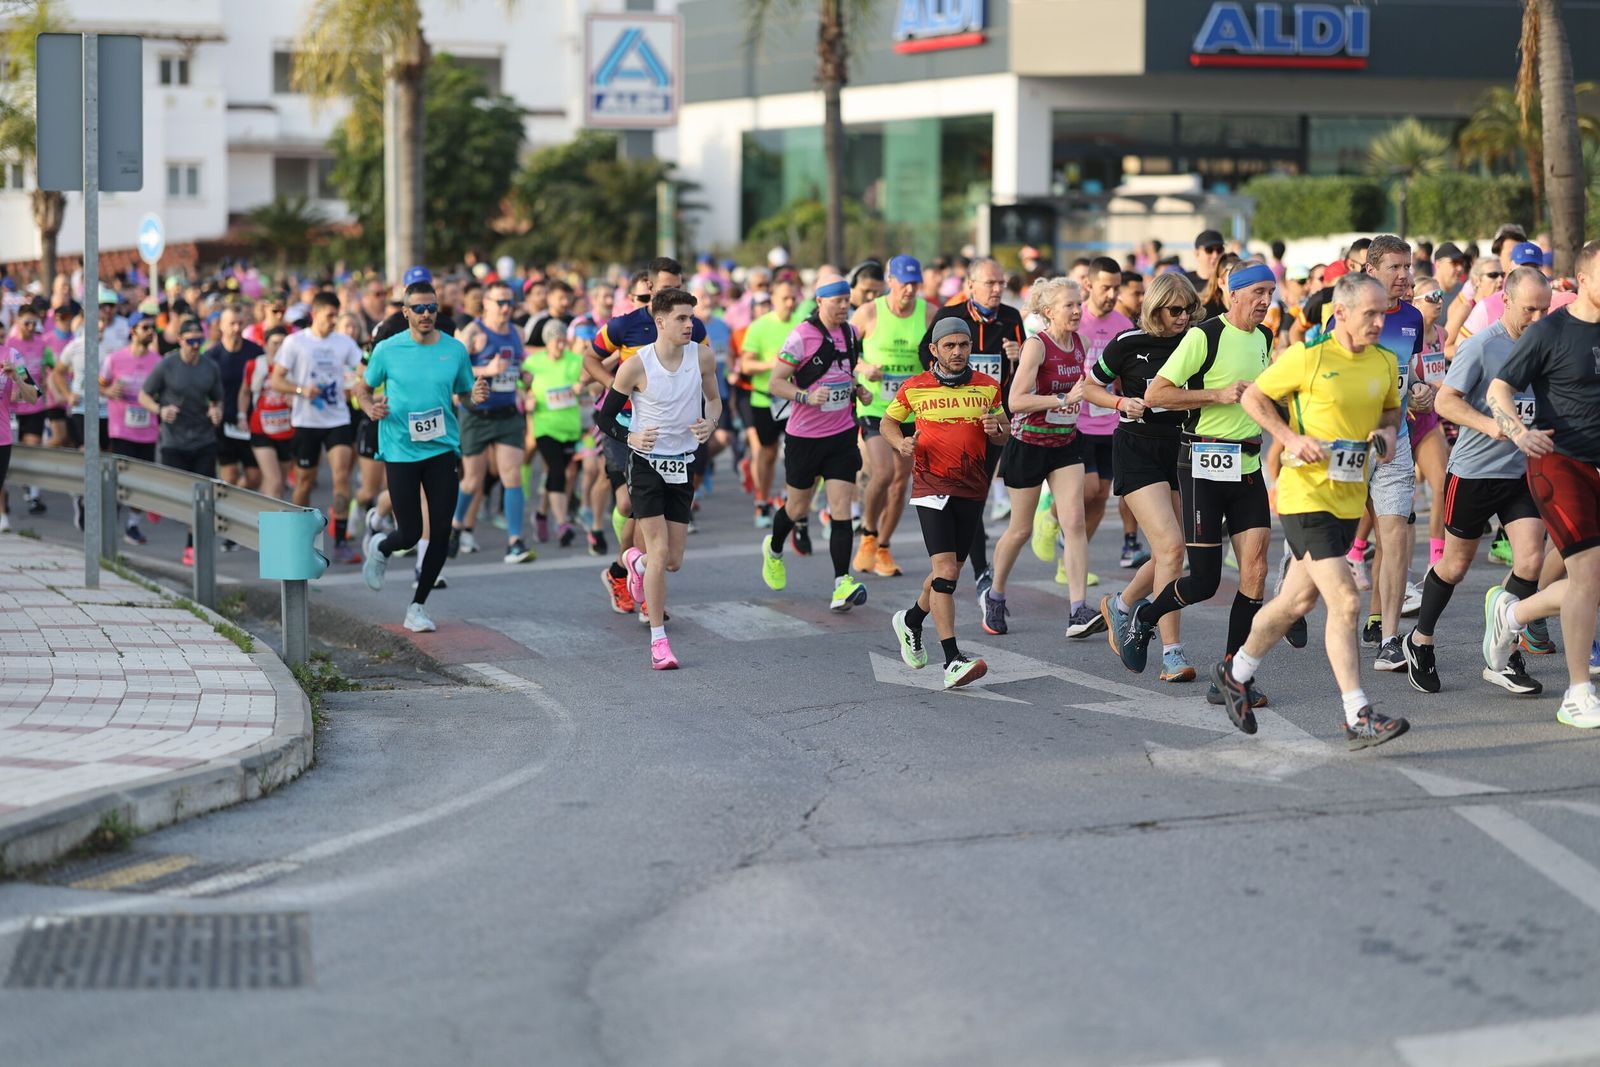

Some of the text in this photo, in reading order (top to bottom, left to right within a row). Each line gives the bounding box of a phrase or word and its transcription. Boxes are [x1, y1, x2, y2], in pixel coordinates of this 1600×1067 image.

[1192, 1, 1370, 56] ALDI
[1057, 364, 1081, 377] Ripon
[415, 418, 438, 432] 631
[651, 460, 685, 474] 1432
[1200, 453, 1234, 469] 503
[1336, 451, 1366, 469] 149
